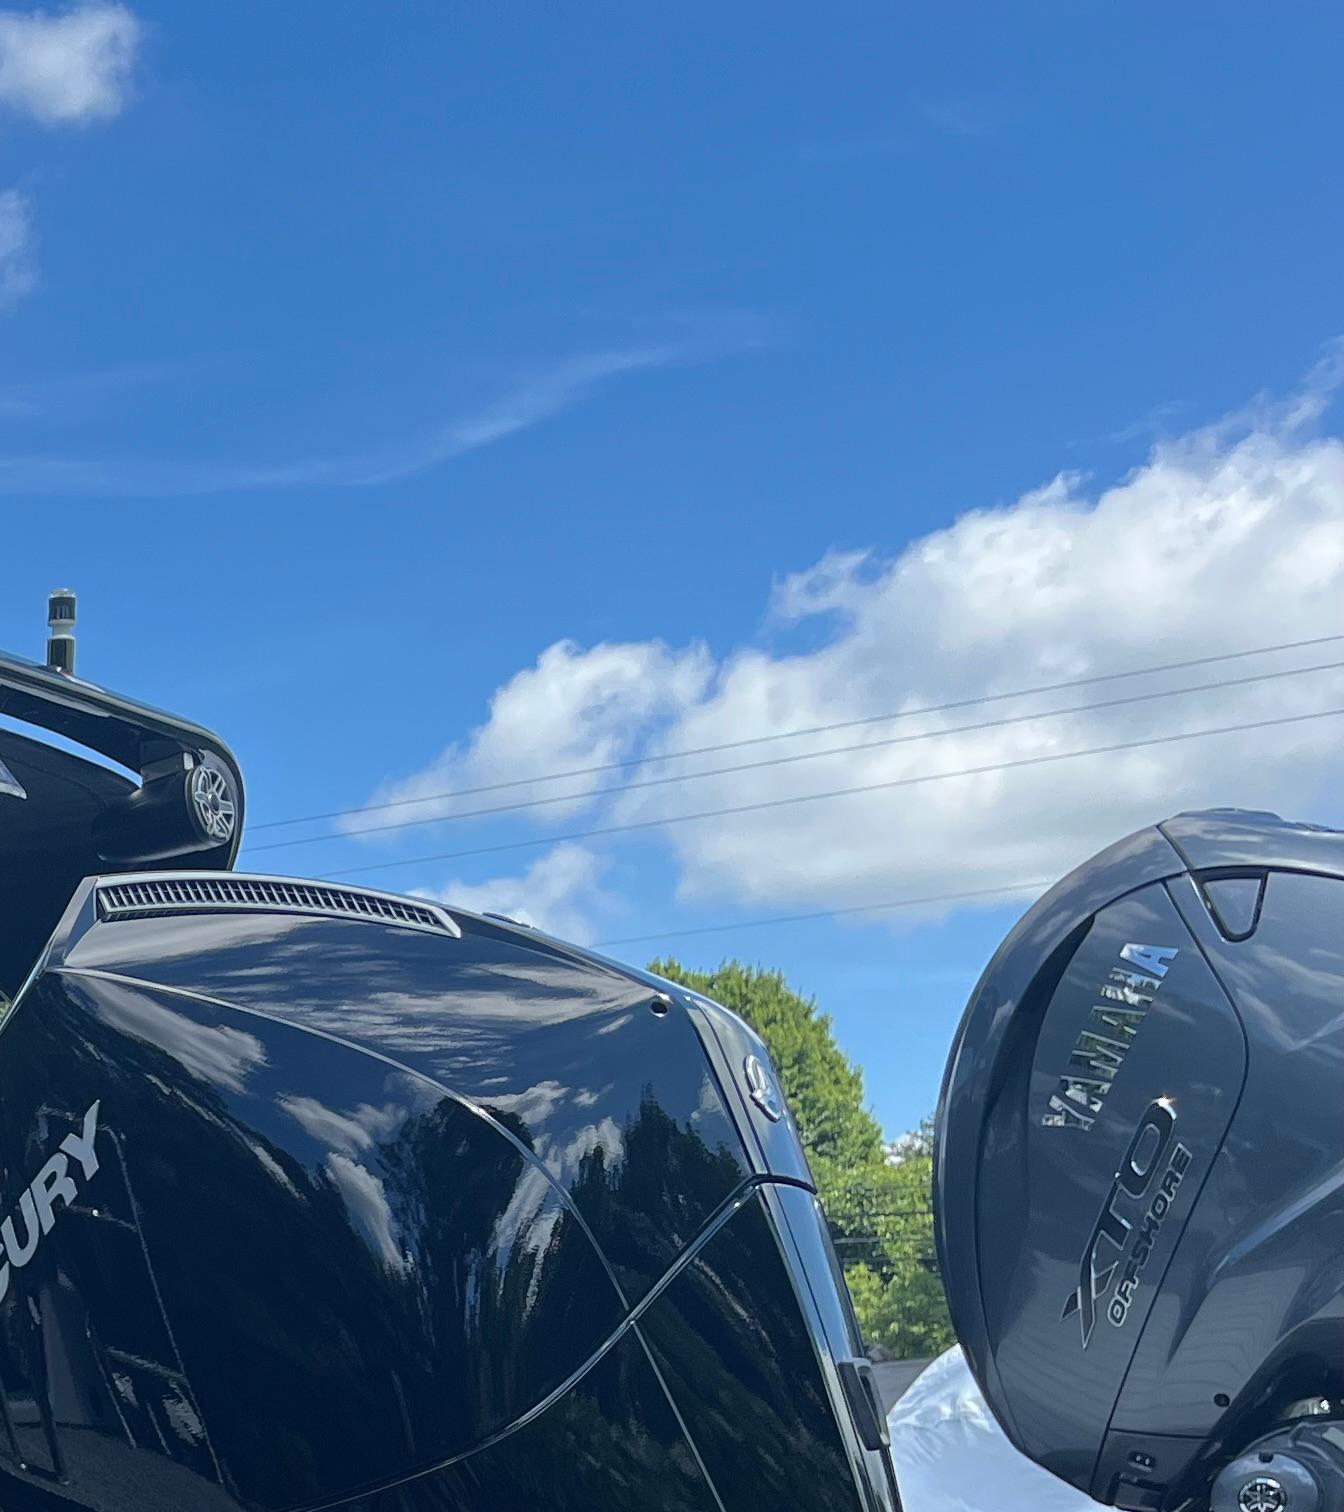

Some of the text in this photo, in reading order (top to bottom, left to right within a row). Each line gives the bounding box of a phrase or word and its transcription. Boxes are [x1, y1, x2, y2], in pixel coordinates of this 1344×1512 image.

[1041, 943, 1178, 1131] YAMAHA
[1060, 1097, 1178, 1350] XTO
[1107, 1142, 1193, 1328] OFFSHORE
